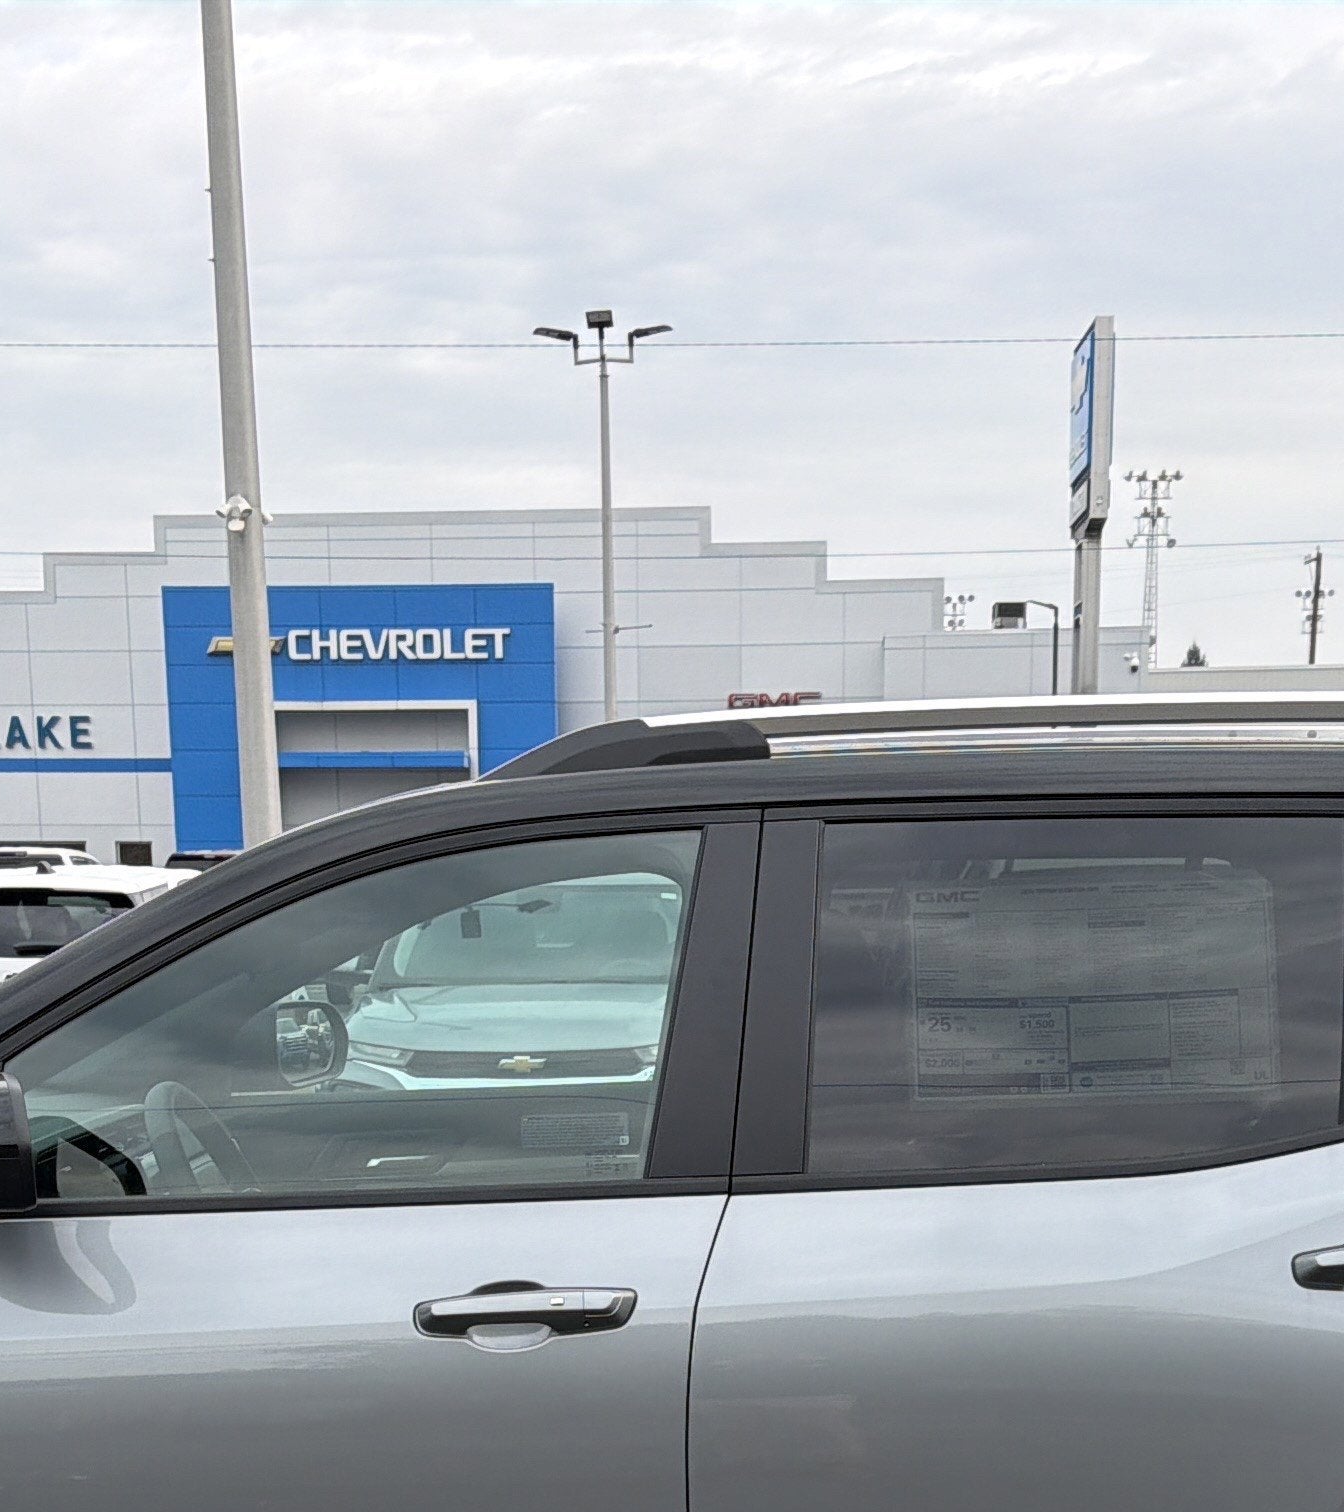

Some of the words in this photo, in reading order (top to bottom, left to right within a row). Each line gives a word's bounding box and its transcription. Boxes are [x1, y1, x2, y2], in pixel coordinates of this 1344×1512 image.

[287, 627, 511, 661] CHEVROLET
[727, 691, 822, 709] GMC
[915, 890, 980, 904] GMC
